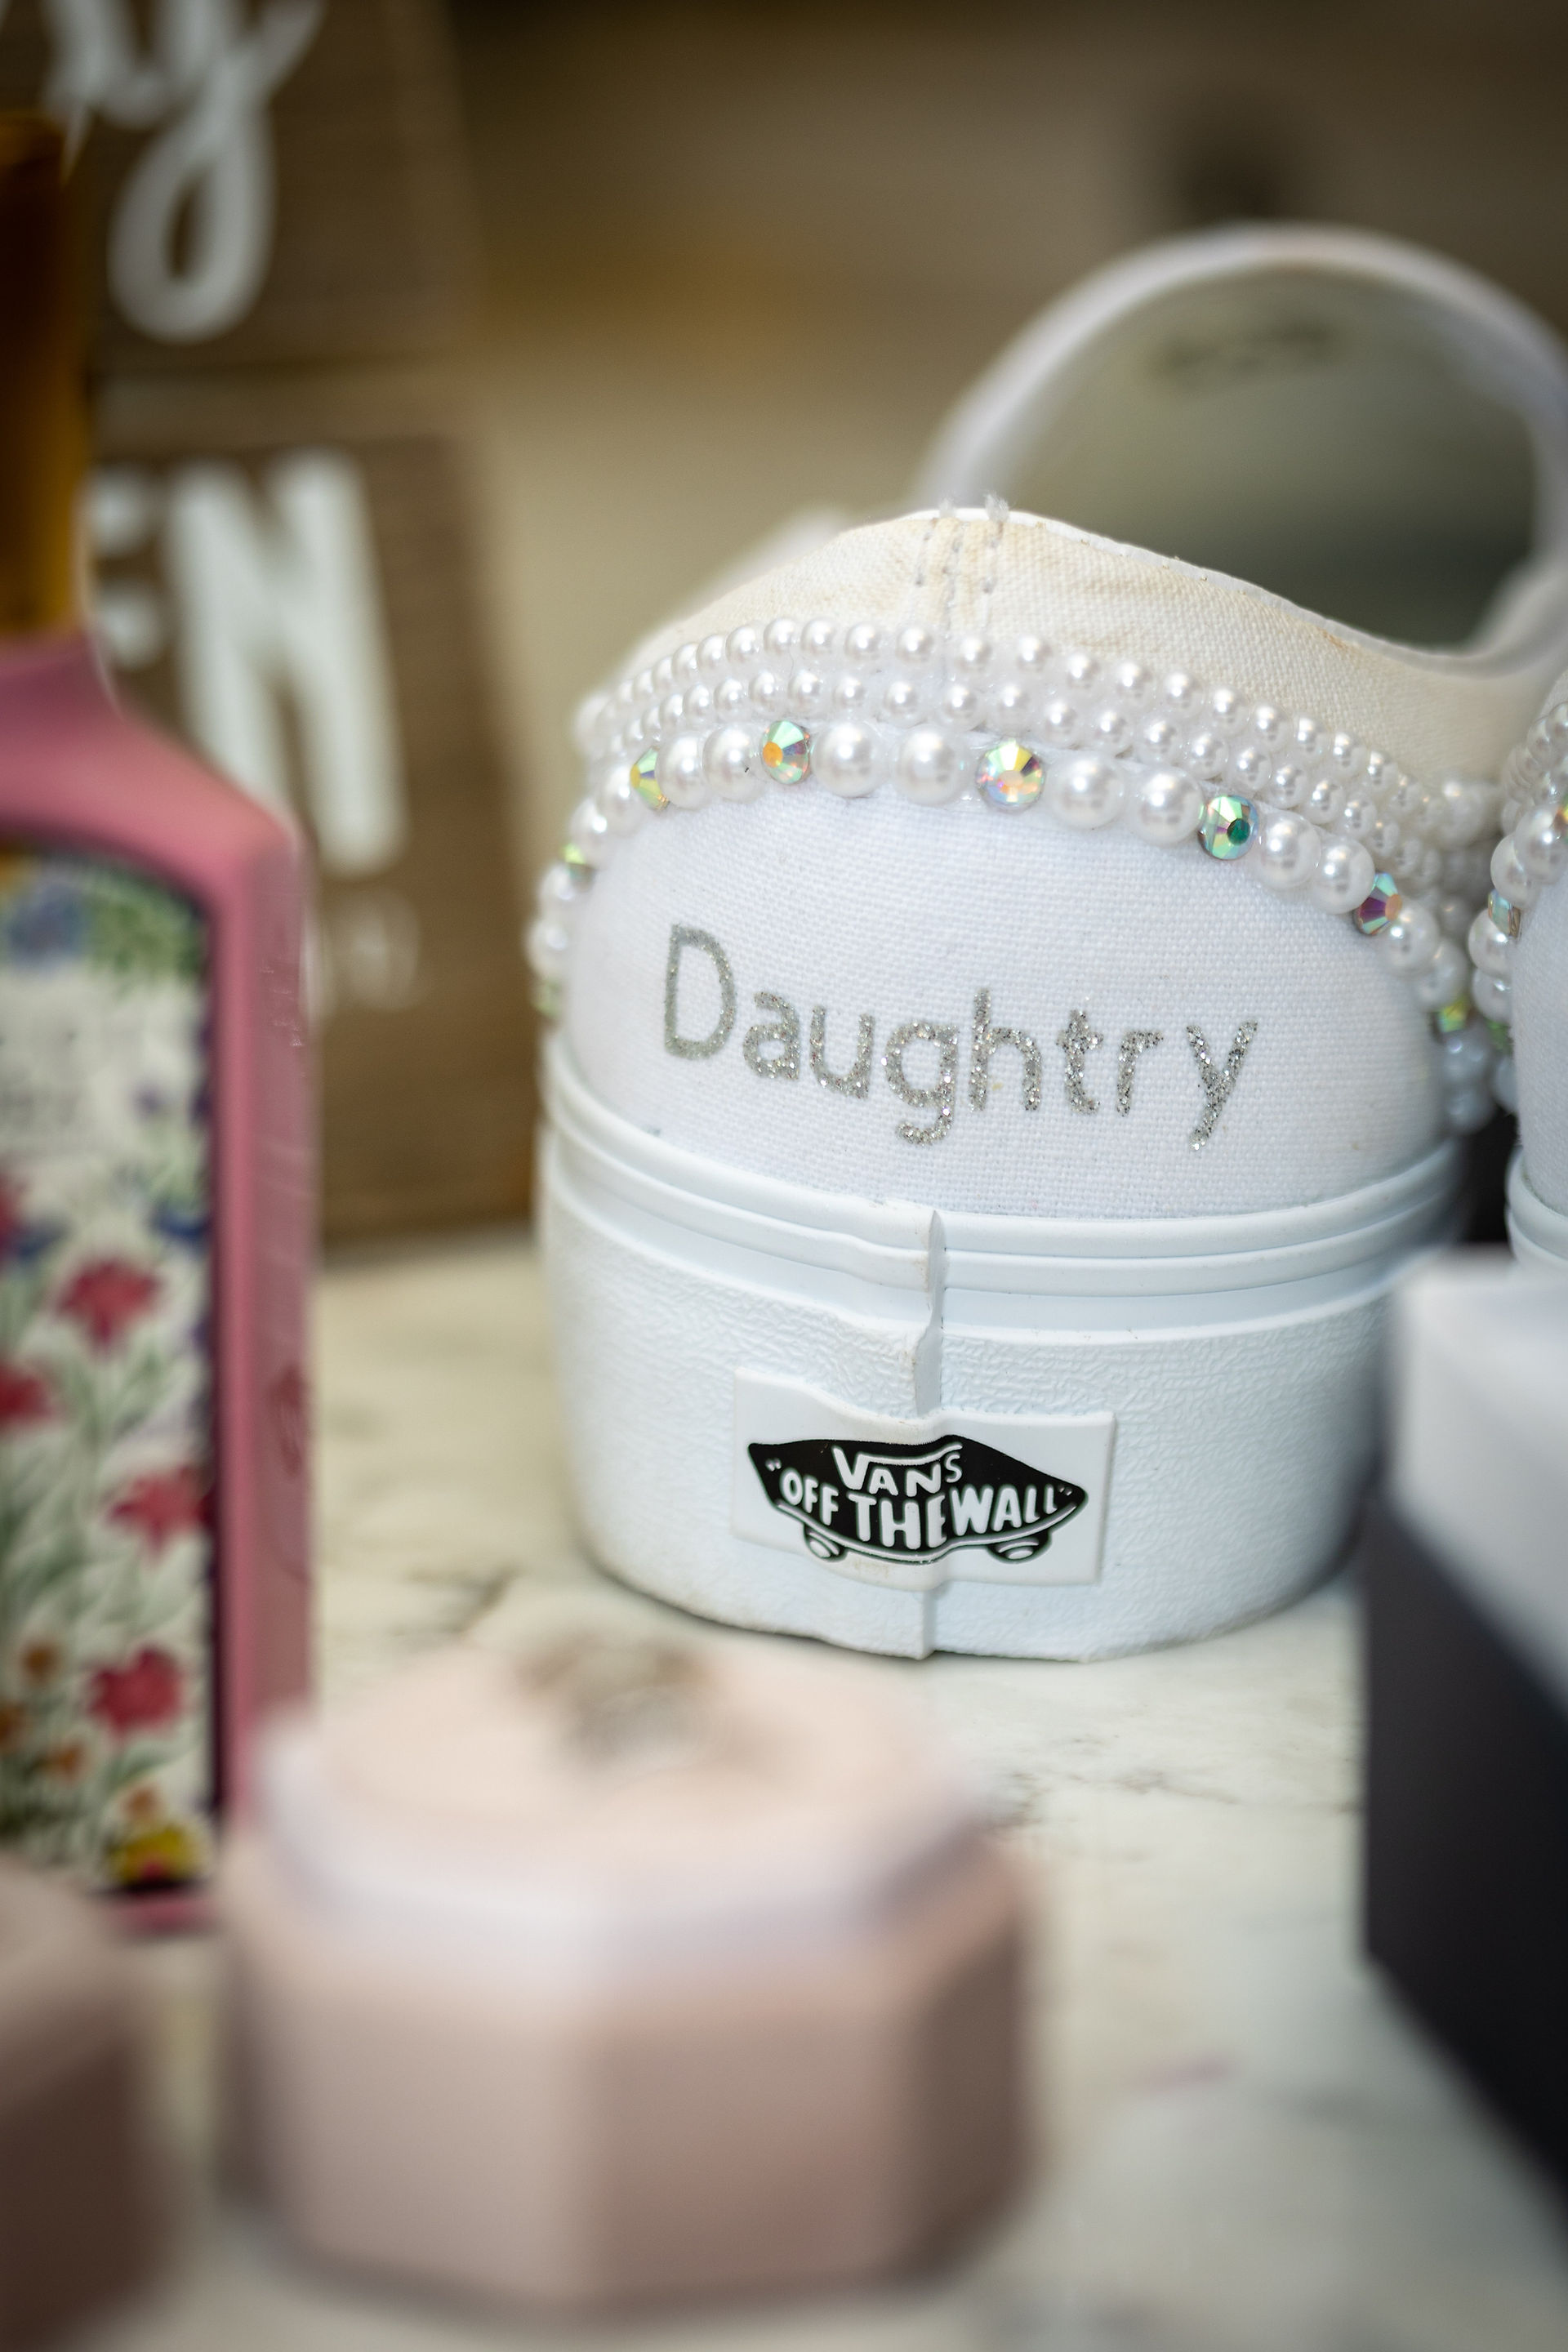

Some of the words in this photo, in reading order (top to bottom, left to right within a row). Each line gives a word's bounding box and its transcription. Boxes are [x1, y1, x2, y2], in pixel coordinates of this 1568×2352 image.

[664, 922, 1258, 1150] Daughtry
[832, 1442, 963, 1497] VANS
[846, 1493, 947, 1550] THE
